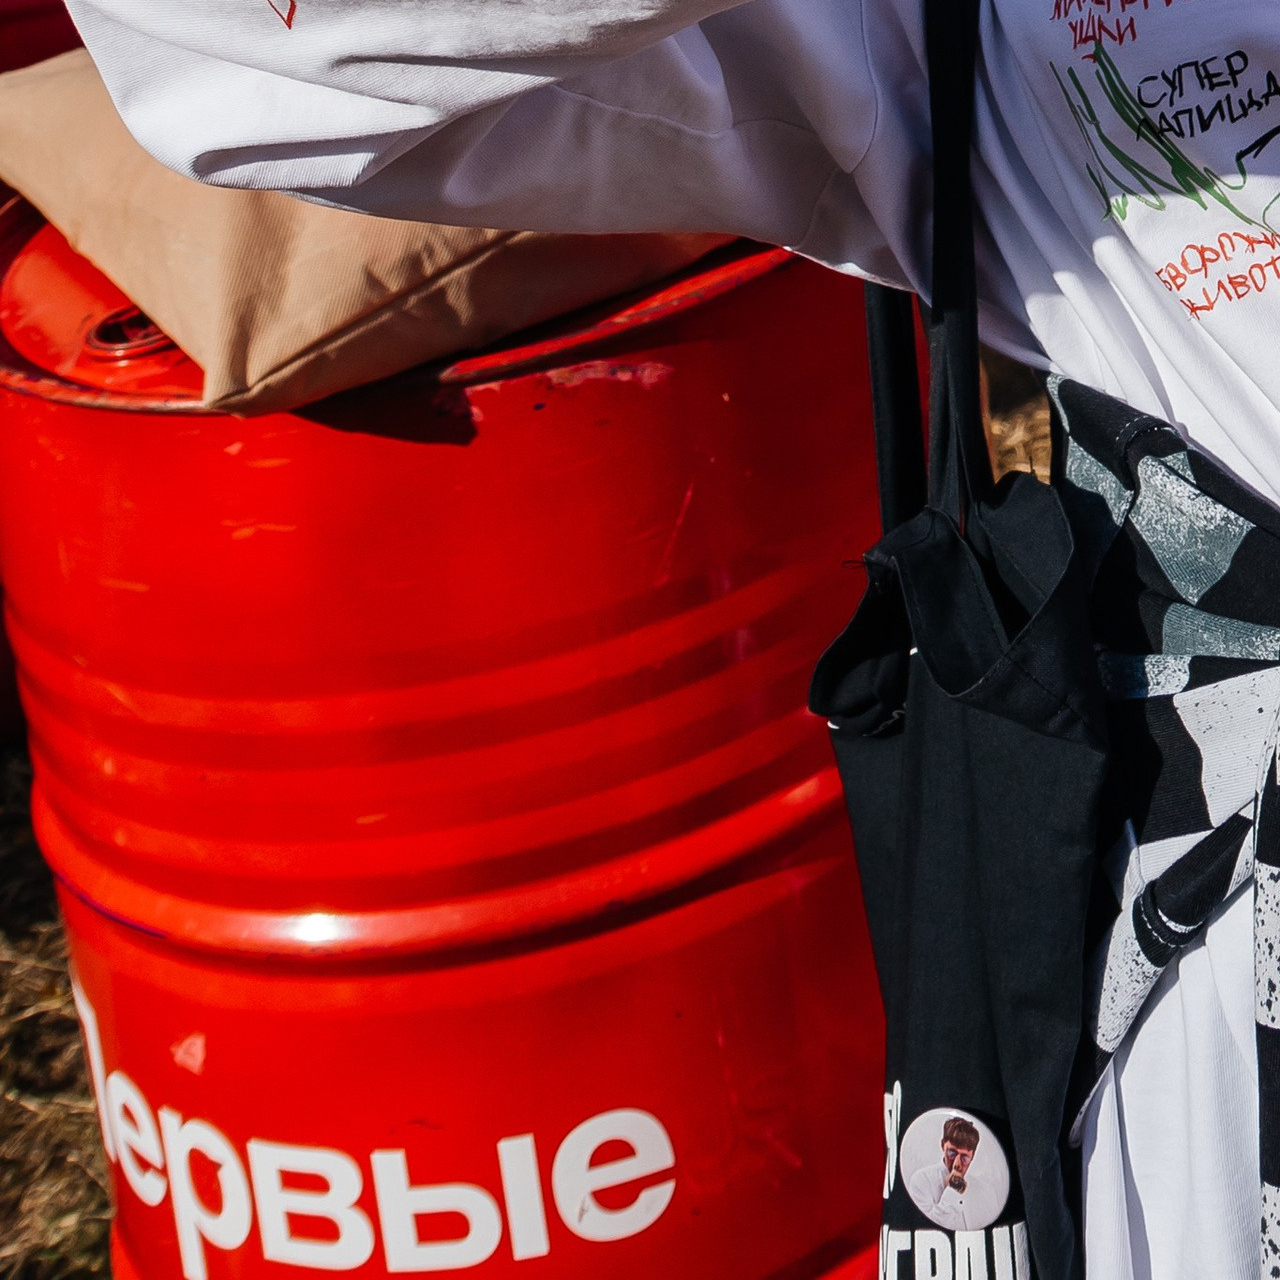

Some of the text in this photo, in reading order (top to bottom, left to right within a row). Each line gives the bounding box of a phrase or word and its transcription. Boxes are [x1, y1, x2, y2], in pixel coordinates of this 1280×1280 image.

[1067, 7, 1138, 51] УШКИ
[1136, 49, 1250, 109] СУПЕР
[70, 974, 677, 1280] ервые
